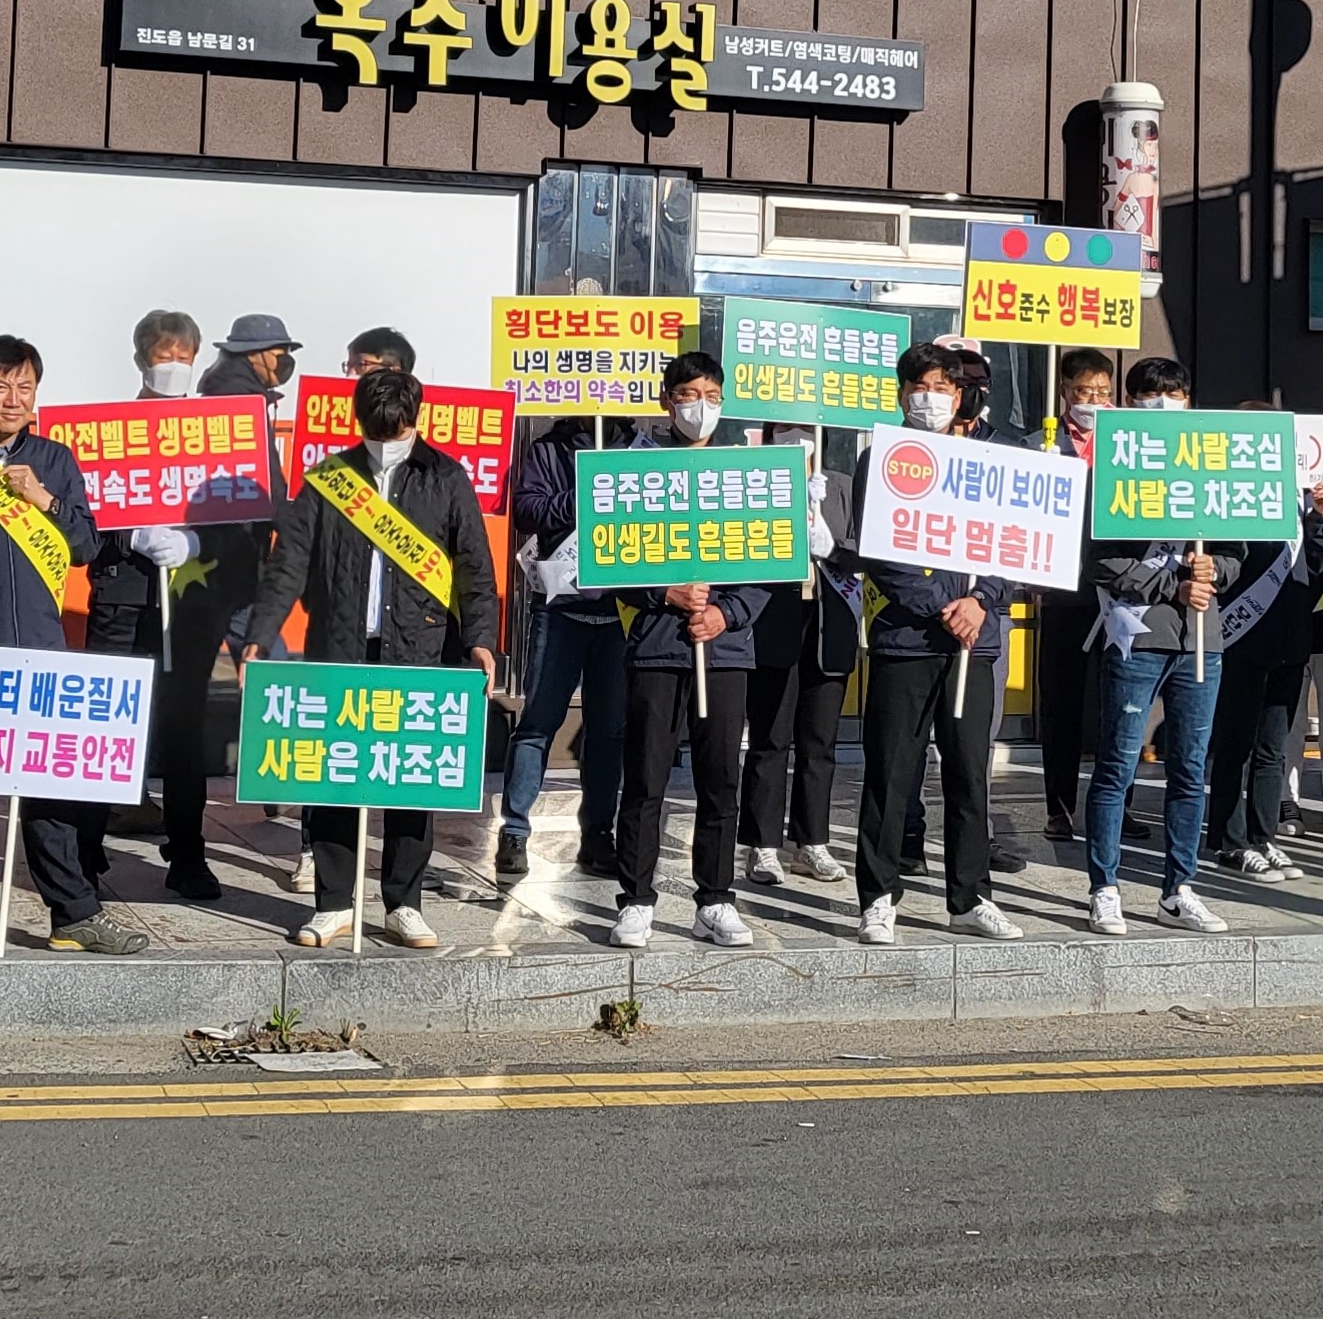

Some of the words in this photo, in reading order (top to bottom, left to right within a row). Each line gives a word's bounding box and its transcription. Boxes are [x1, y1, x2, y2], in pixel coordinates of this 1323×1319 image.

[136, 27, 183, 49] 진도읍
[187, 30, 233, 52] 남문길
[237, 35, 256, 52] 31
[746, 65, 897, 101] T.544-2483
[505, 309, 620, 340] 횡단보도
[629, 310, 686, 340] 이용
[972, 278, 1051, 324] 신호준수
[1057, 282, 1134, 329] 행복보장
[513, 350, 549, 374] 나의
[556, 350, 613, 374] 생명을
[736, 318, 819, 359] 음주운전
[823, 325, 898, 368] 흔들흔들
[734, 362, 818, 403] 인생길도
[822, 372, 897, 412] 흔들흔들
[156, 414, 257, 457] 생명벨트
[1111, 430, 1166, 470] 차는
[1174, 431, 1282, 472] 사람조심
[158, 463, 259, 507] 생명속도
[592, 470, 690, 513] 음주운전
[697, 468, 793, 512] 흔들흔들
[887, 459, 933, 480] STOP
[941, 456, 1004, 507] 사람이
[1010, 467, 1073, 519] 보이면
[1110, 481, 1196, 519] 사람은
[1203, 480, 1284, 520] 차조심
[592, 522, 692, 564] 인생길도
[697, 519, 794, 561] 흔들흔들
[892, 508, 957, 553] 일단
[965, 519, 1054, 573] 멈춤!!
[30, 671, 142, 723] 배운질서
[263, 683, 327, 729] 차는
[337, 688, 469, 735] 사람조심
[22, 731, 135, 782] 교통안전
[258, 739, 359, 784] 사람은
[368, 742, 466, 788] 차조심
